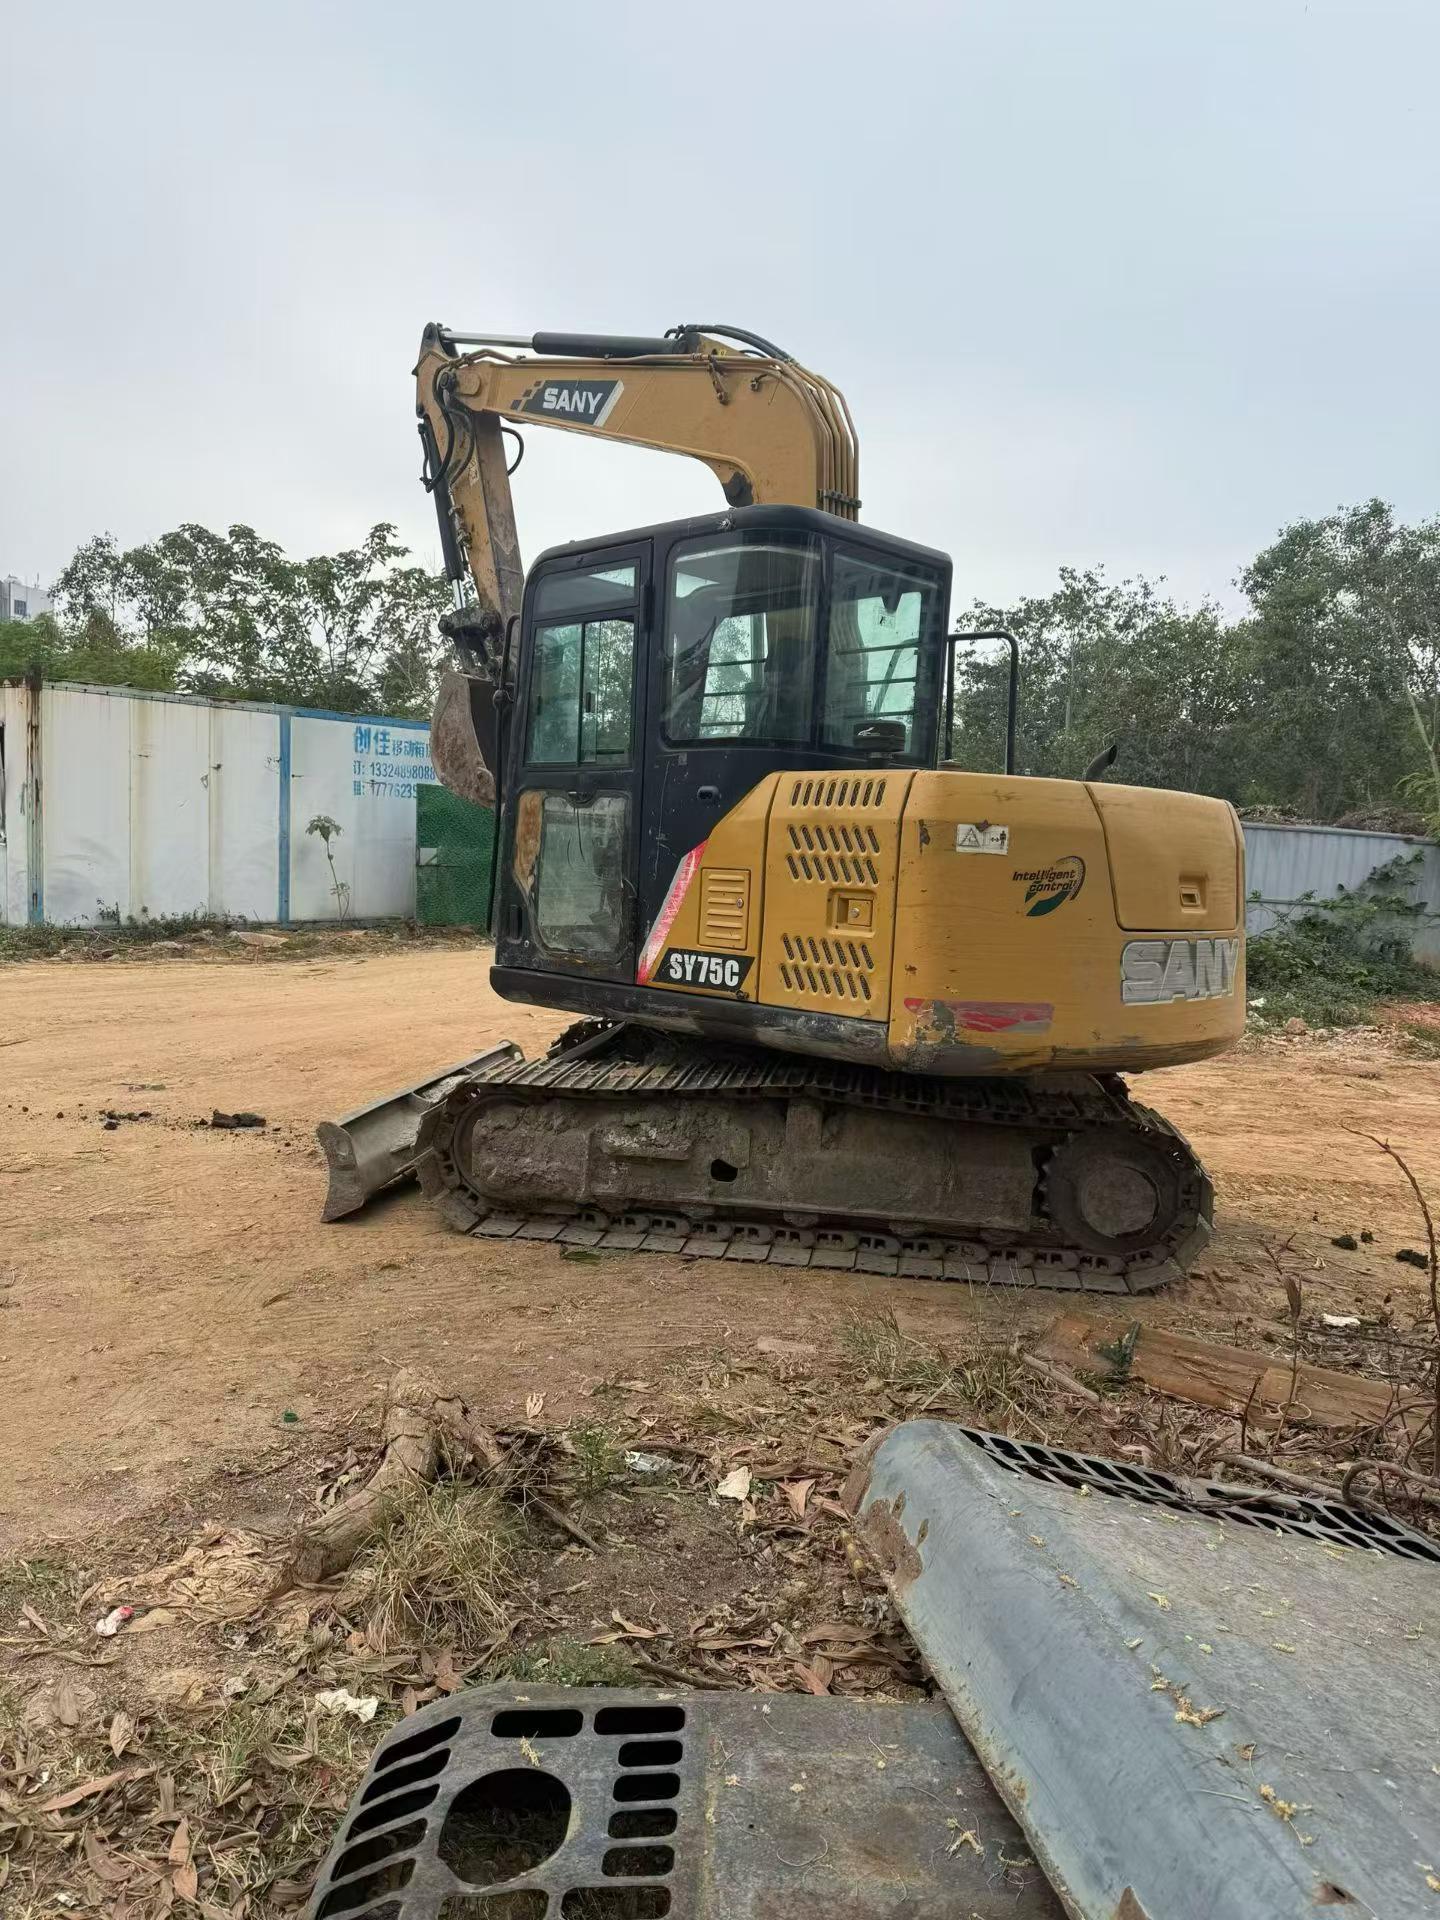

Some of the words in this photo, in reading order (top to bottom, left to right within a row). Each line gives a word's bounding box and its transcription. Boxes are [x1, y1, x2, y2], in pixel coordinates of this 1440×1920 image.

[542, 387, 603, 415] SANY
[1013, 868, 1076, 882] Intelligent
[669, 952, 740, 987] SY75C
